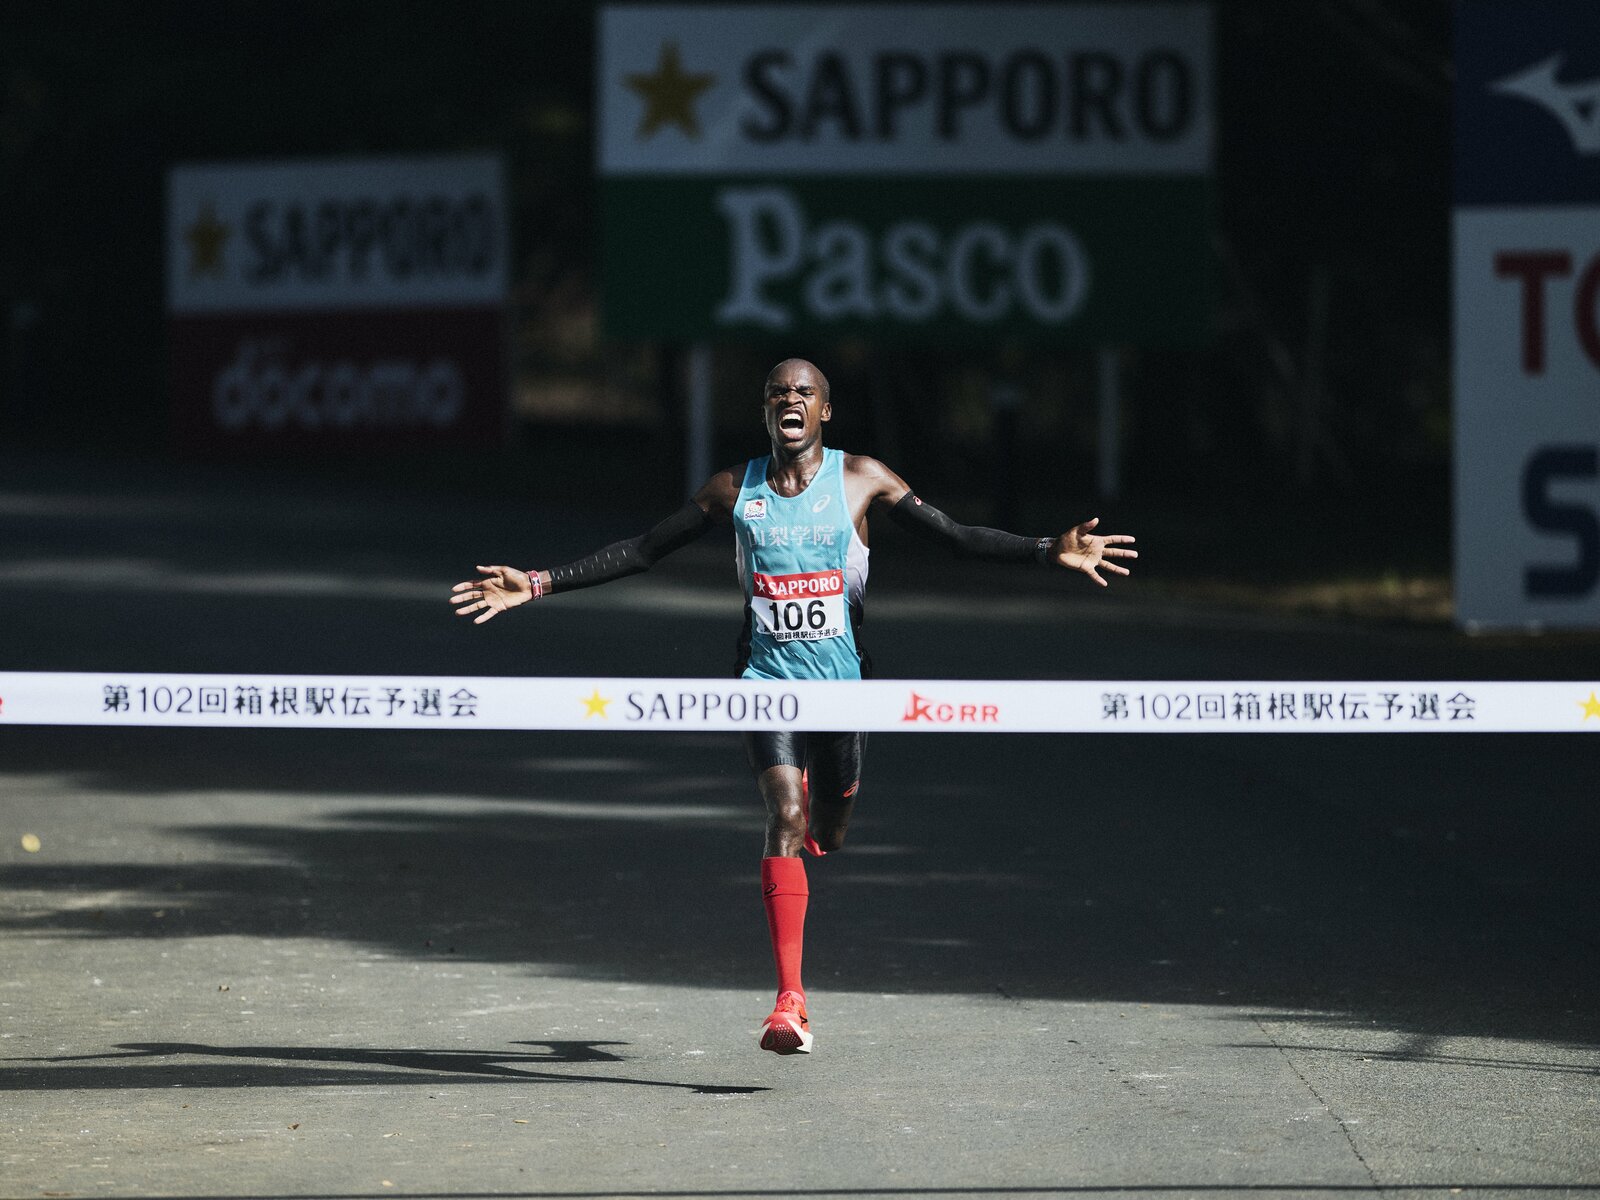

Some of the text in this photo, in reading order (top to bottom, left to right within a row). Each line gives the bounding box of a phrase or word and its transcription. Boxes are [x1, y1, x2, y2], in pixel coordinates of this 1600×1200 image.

[743, 48, 1195, 142] SAPPORO
[246, 193, 496, 284] SAPPORO
[712, 183, 1092, 331] Pasco
[1495, 250, 1600, 377] T
[212, 338, 466, 430] docomo
[748, 525, 834, 548] 山梨学院
[768, 575, 840, 596] SAPPORO
[769, 600, 827, 631] 106
[103, 685, 477, 717] 第102回箱根駅伝予選会
[626, 692, 800, 722] SAPPORO
[1102, 692, 1476, 721] 第102回箱根駅伝予選会
